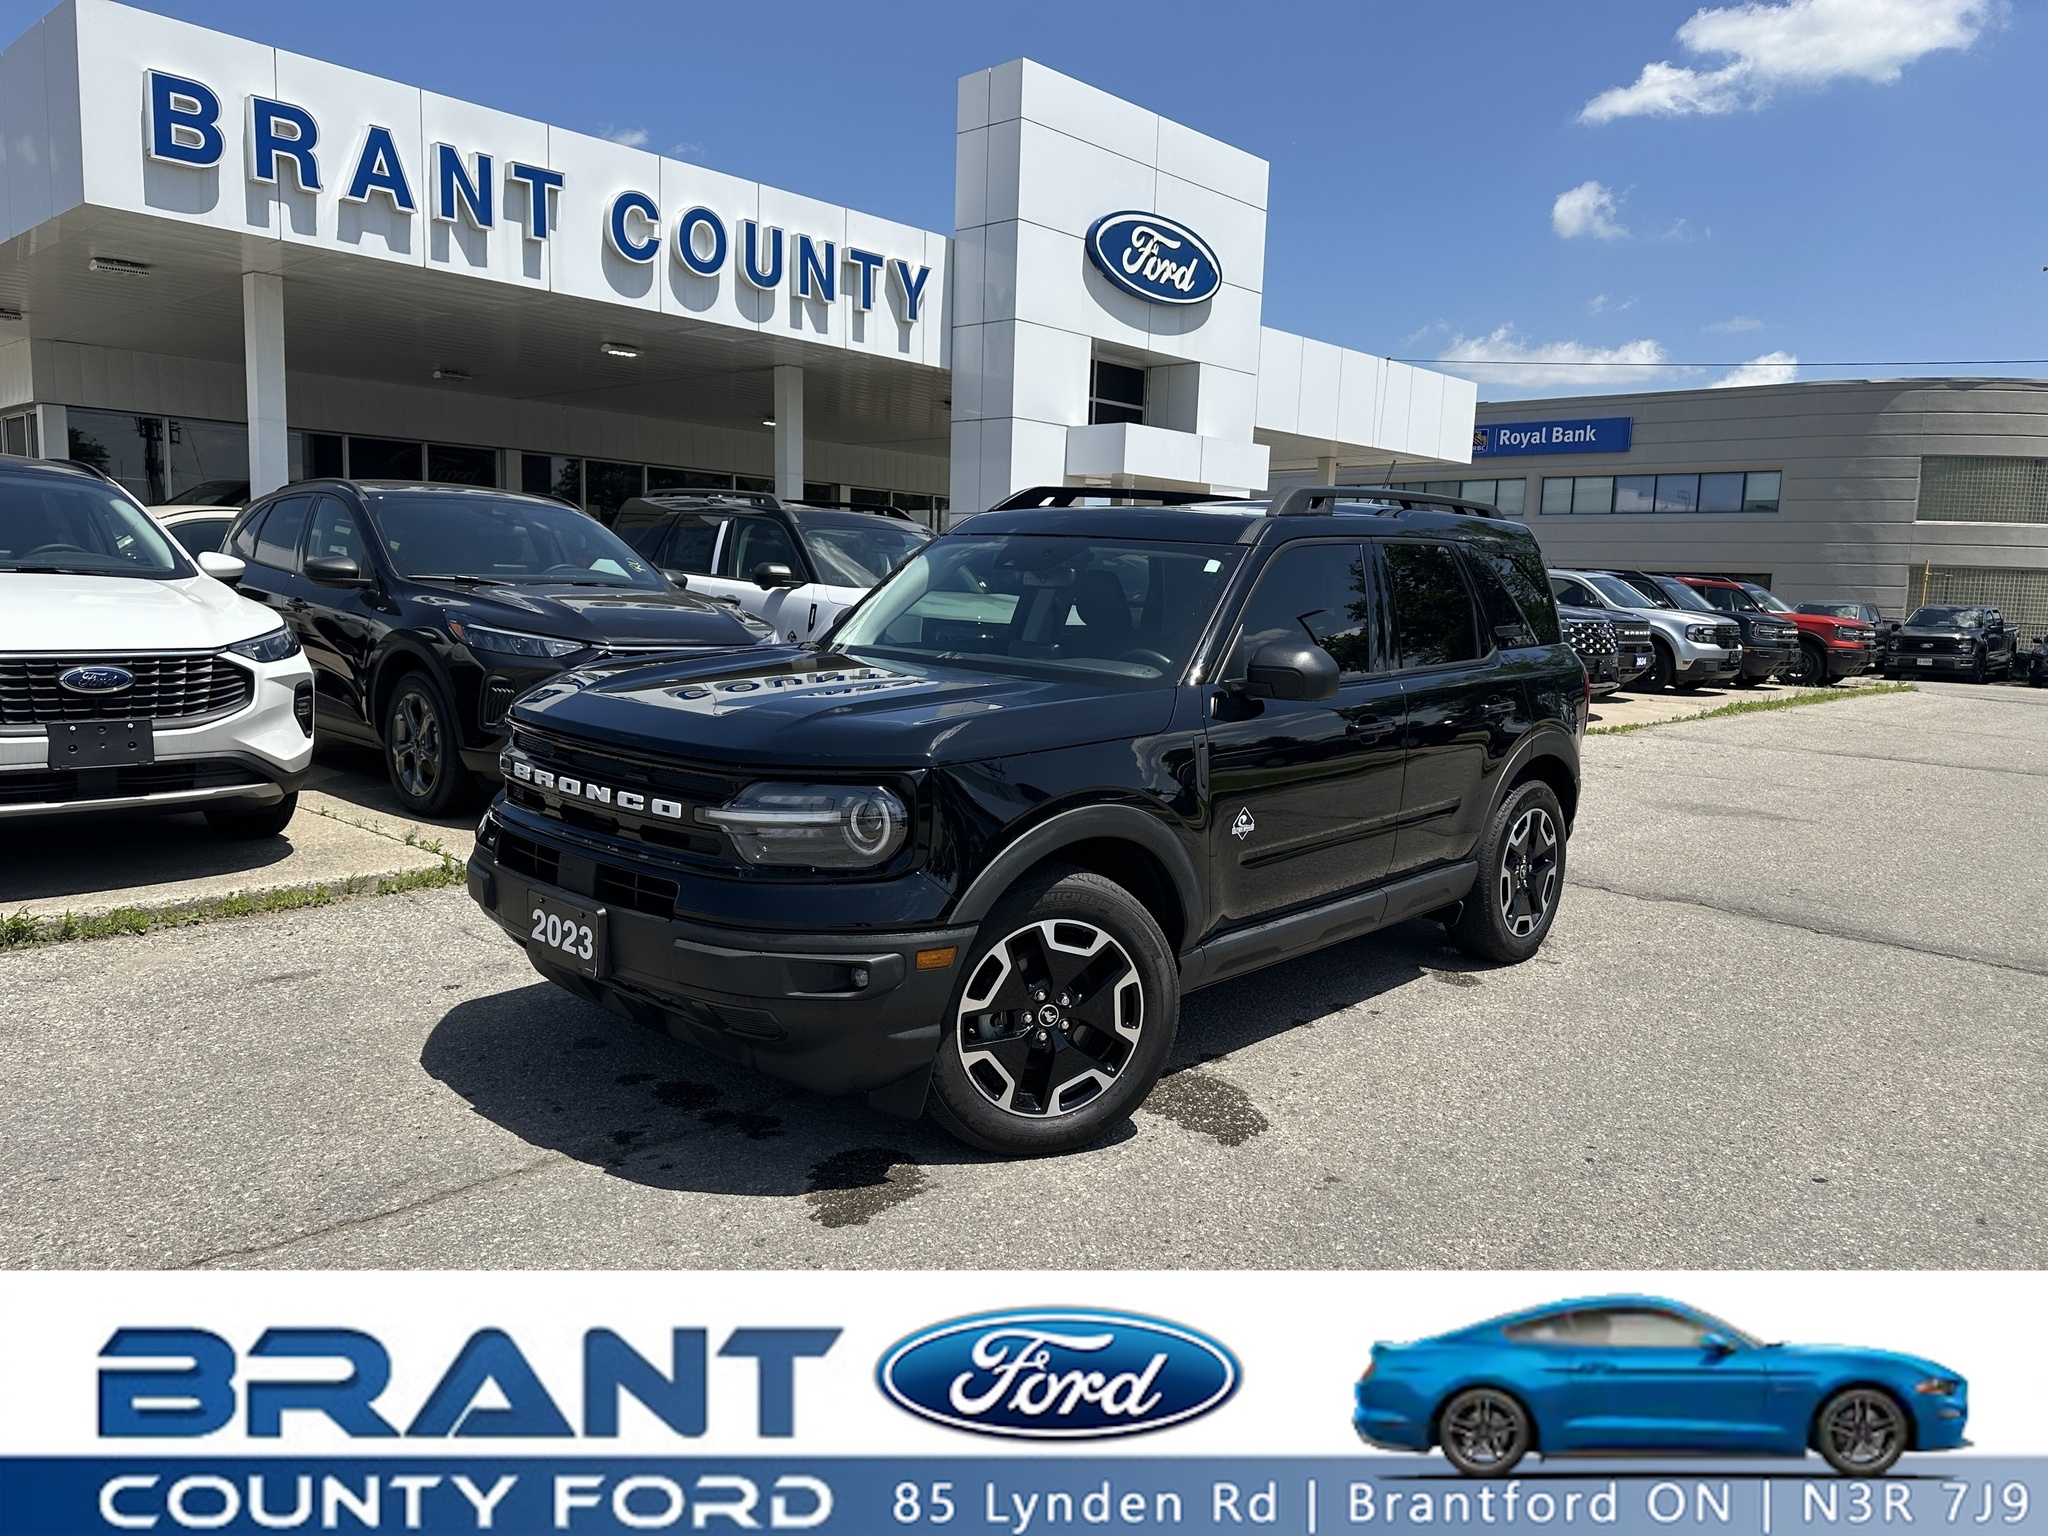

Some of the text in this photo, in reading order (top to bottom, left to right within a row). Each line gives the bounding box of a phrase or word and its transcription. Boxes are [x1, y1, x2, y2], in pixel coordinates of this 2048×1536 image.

[143, 68, 931, 323] BRANT COUNTY
[1122, 225, 1199, 293] Ford
[1499, 425, 1597, 448] Royal Bank
[78, 671, 119, 688] Ford
[513, 761, 682, 819] BRONCO
[530, 908, 593, 961] 2023
